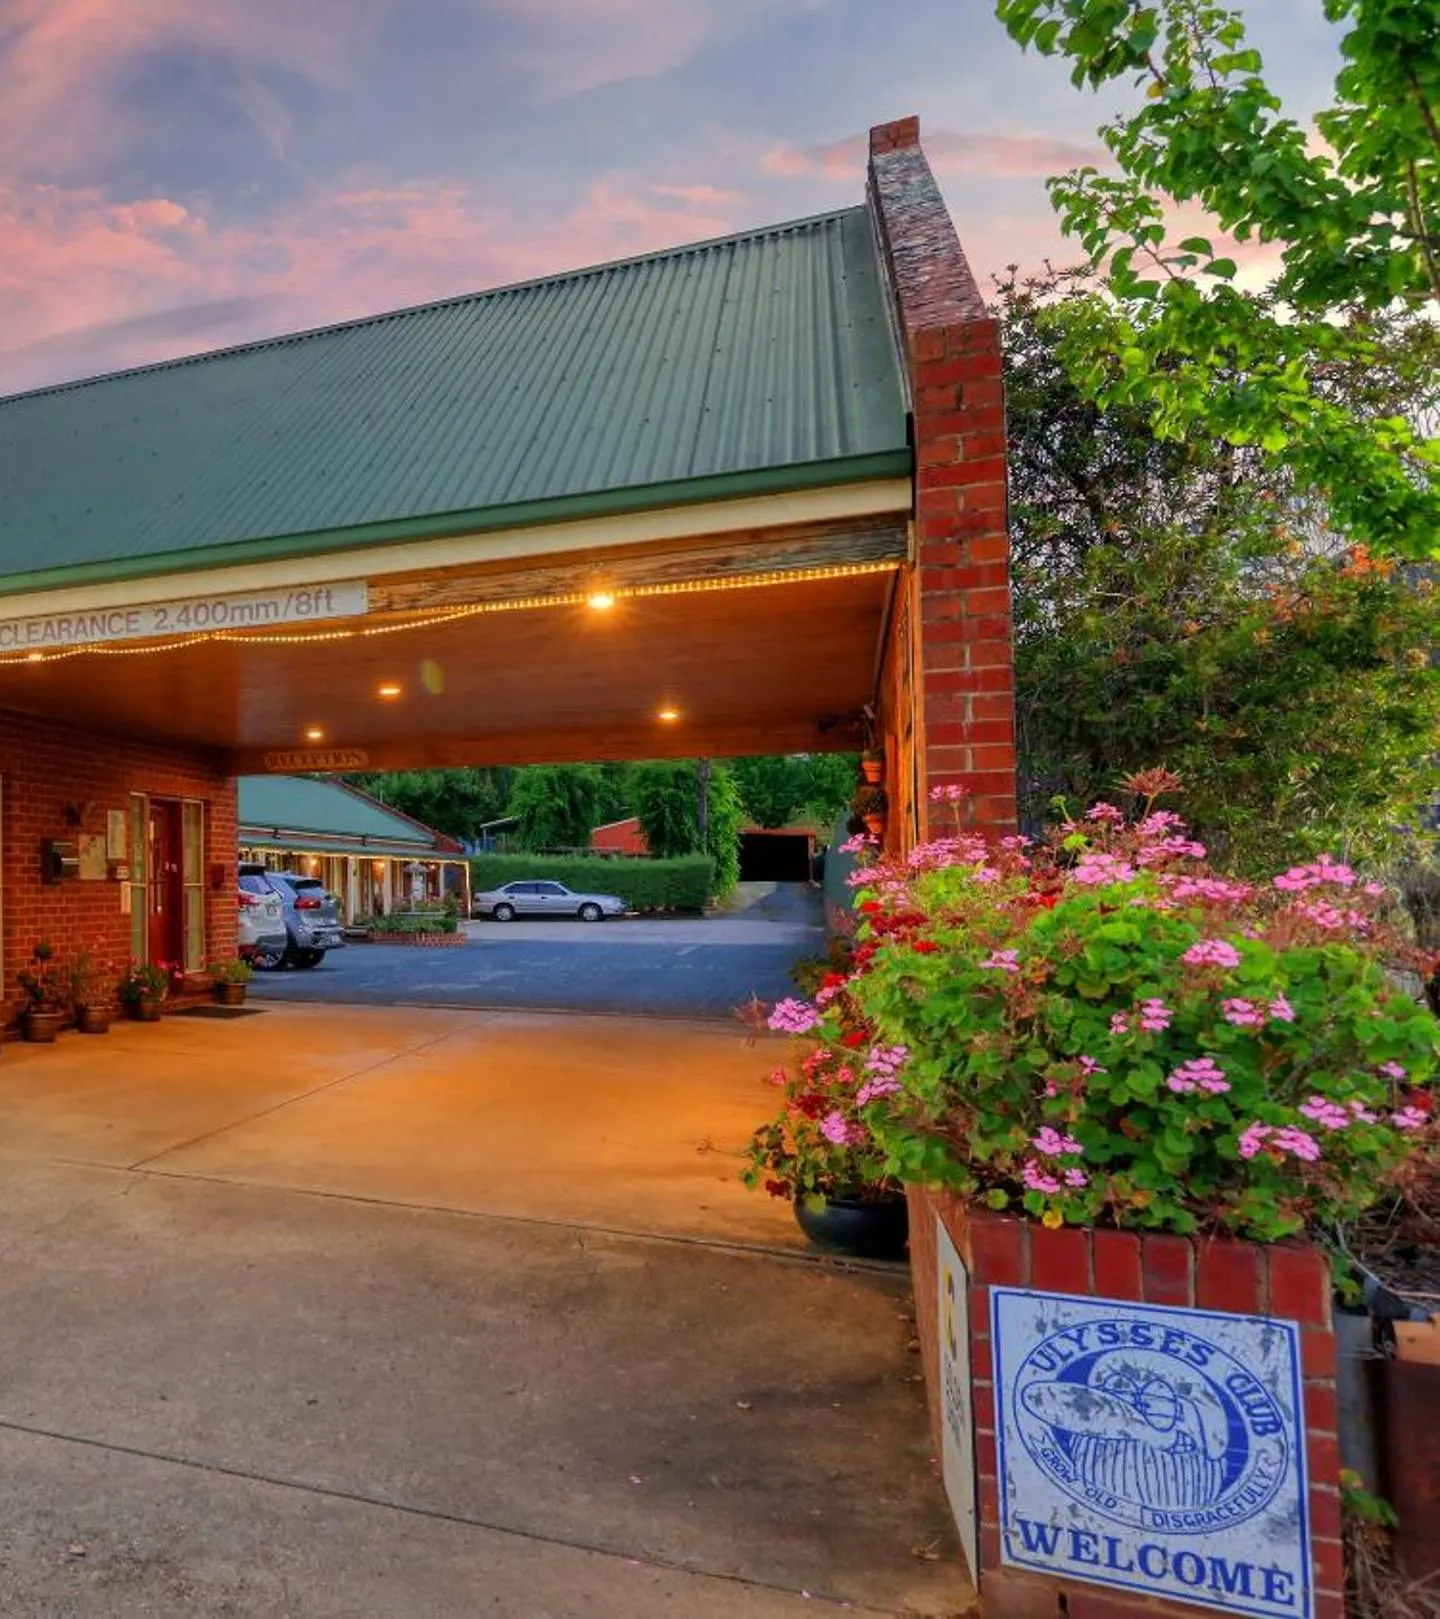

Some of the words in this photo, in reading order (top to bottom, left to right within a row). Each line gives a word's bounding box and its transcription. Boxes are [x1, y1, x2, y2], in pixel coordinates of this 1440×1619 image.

[1029, 1322, 1215, 1373] ULYSSES
[1225, 1372, 1282, 1437] CLUB
[1040, 1448, 1080, 1485] GROW
[1084, 1484, 1117, 1510] OLD
[1150, 1465, 1274, 1529] DISGRACEFULLY
[1015, 1518, 1296, 1606] WELCOME
